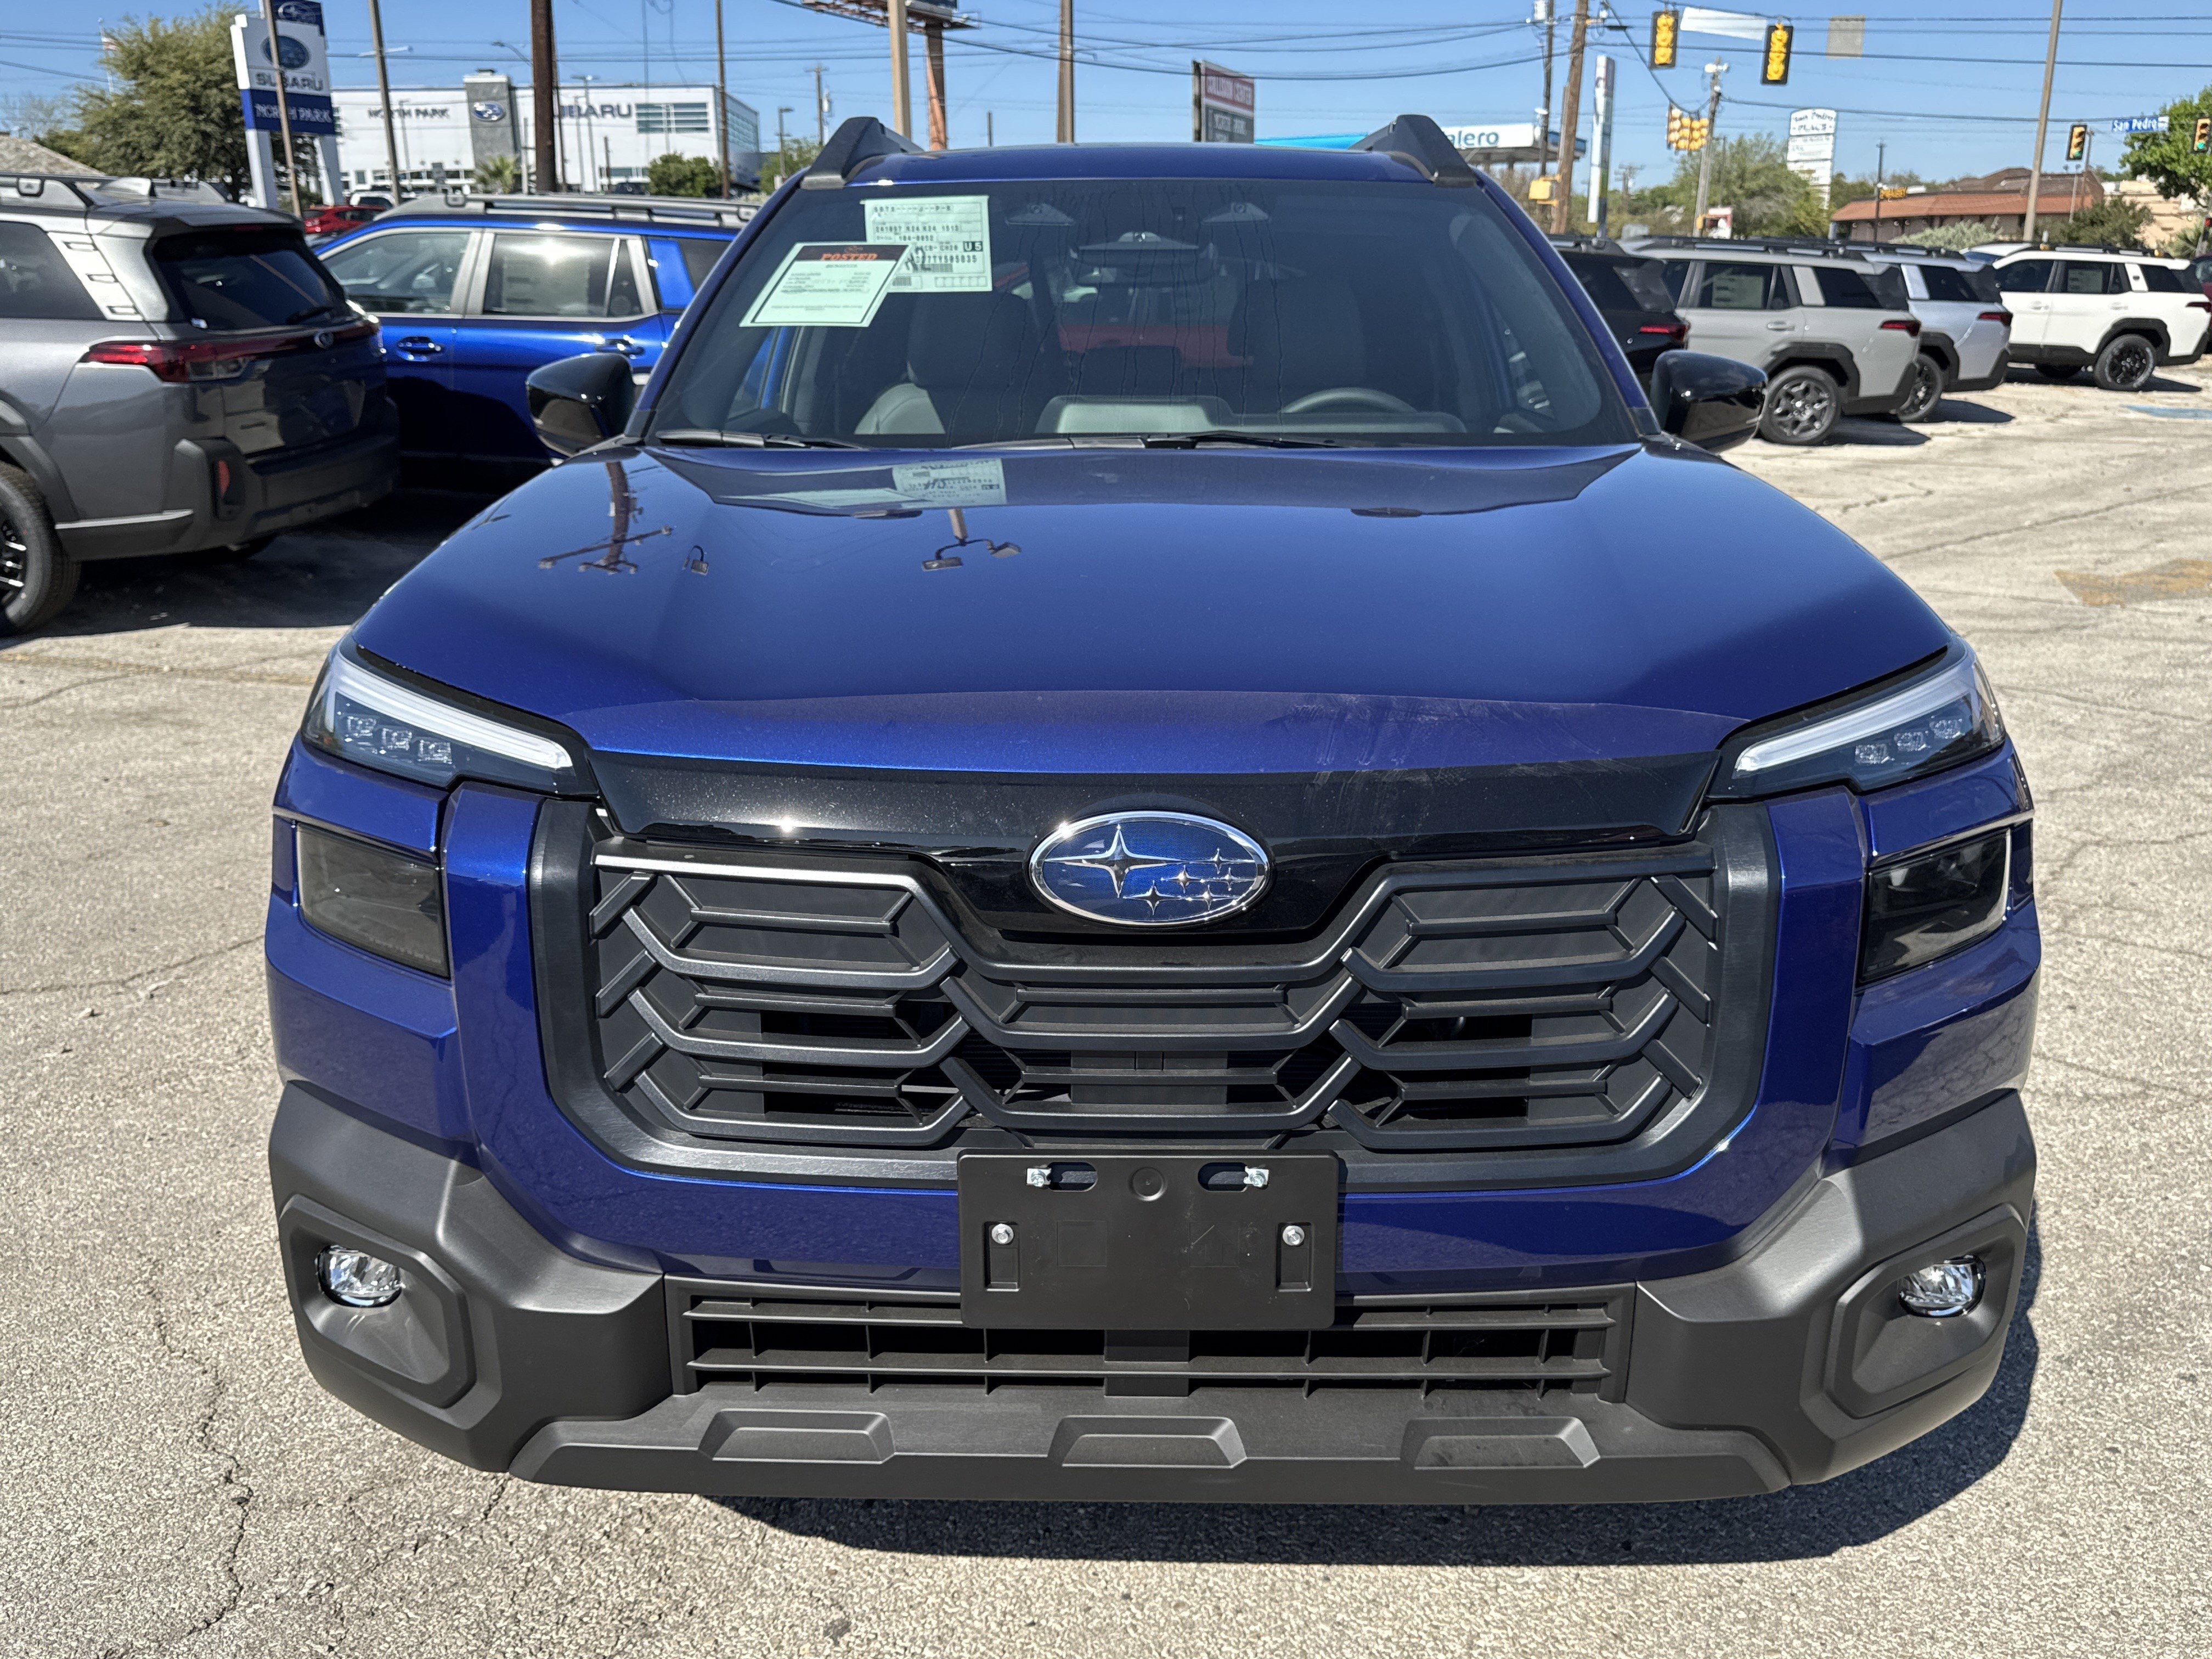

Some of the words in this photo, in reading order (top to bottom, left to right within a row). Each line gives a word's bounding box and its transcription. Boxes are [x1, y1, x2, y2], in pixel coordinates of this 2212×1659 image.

[2113, 120, 2130, 132] San
[2131, 117, 2157, 131] Pedro
[1447, 131, 1499, 145] alero
